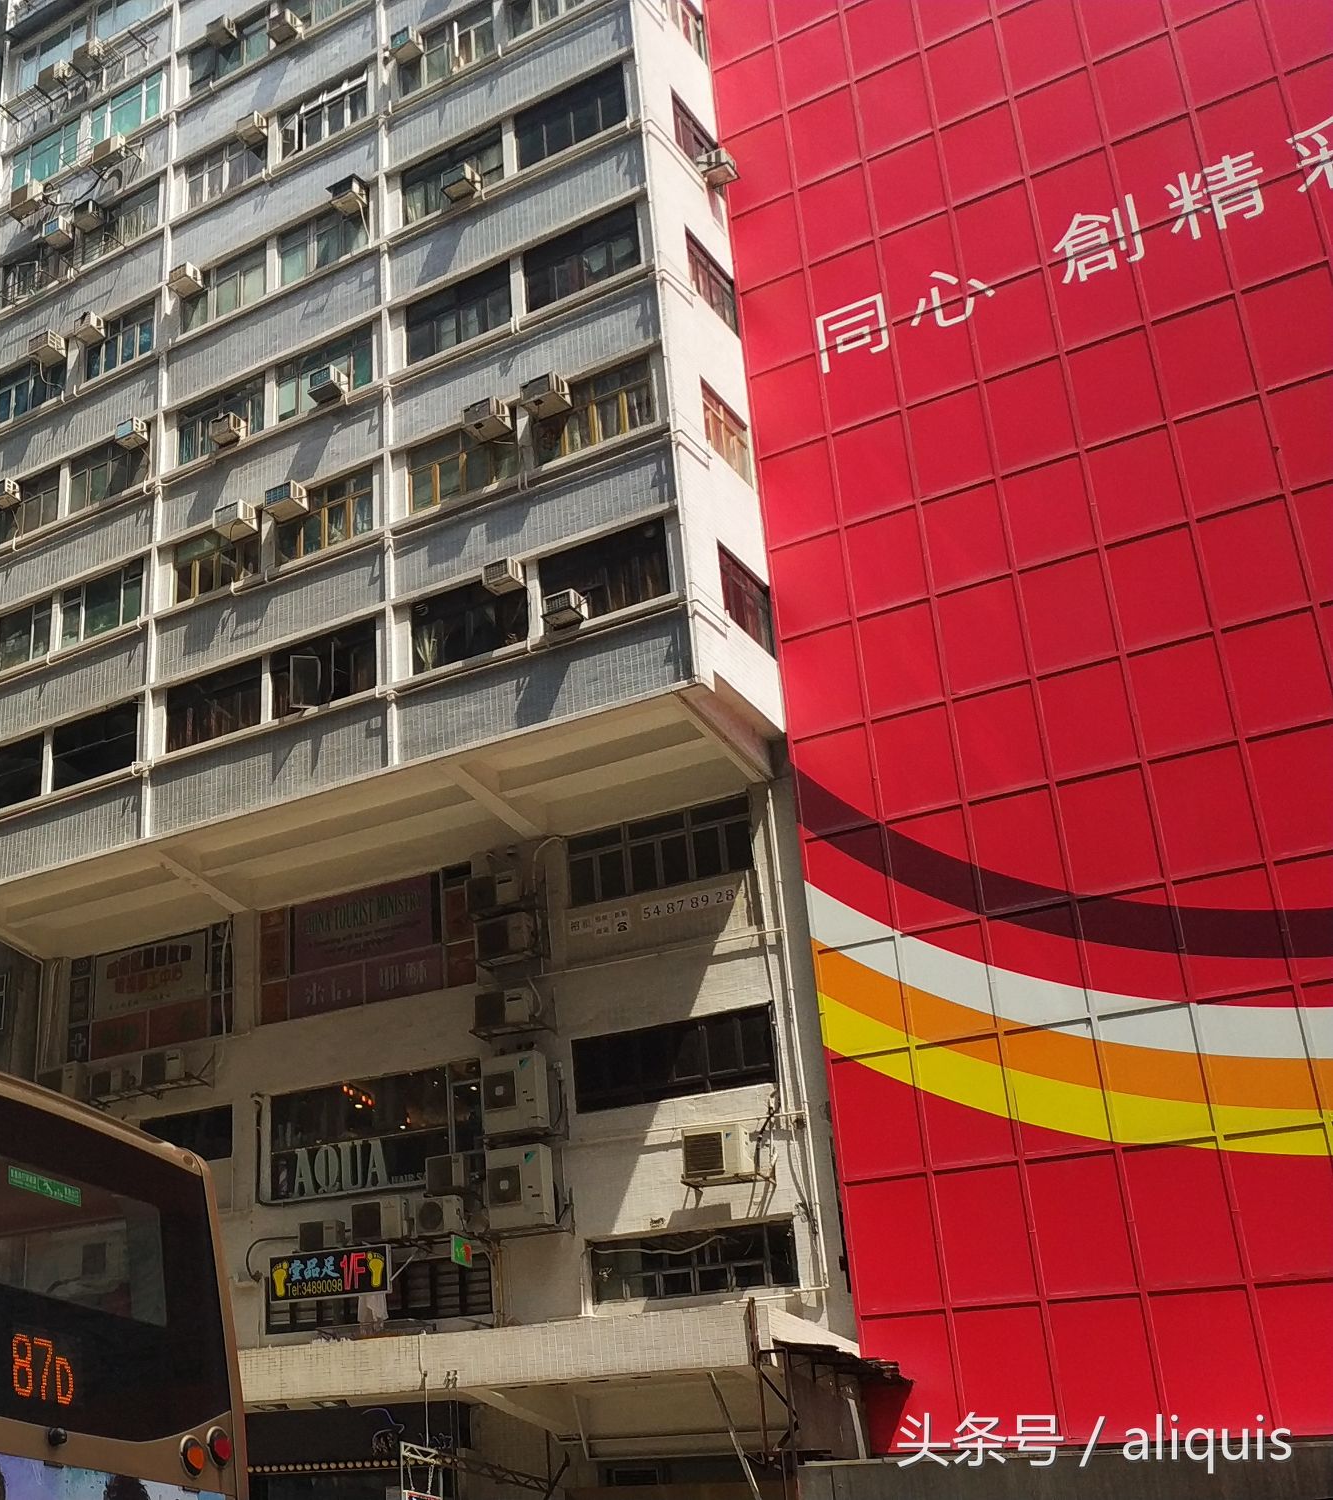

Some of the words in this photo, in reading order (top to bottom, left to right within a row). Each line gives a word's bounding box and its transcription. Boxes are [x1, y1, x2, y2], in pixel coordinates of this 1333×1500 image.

[815, 270, 995, 374] 同心
[292, 1138, 389, 1198] AQUA
[11, 1333, 76, 1406] 87D
